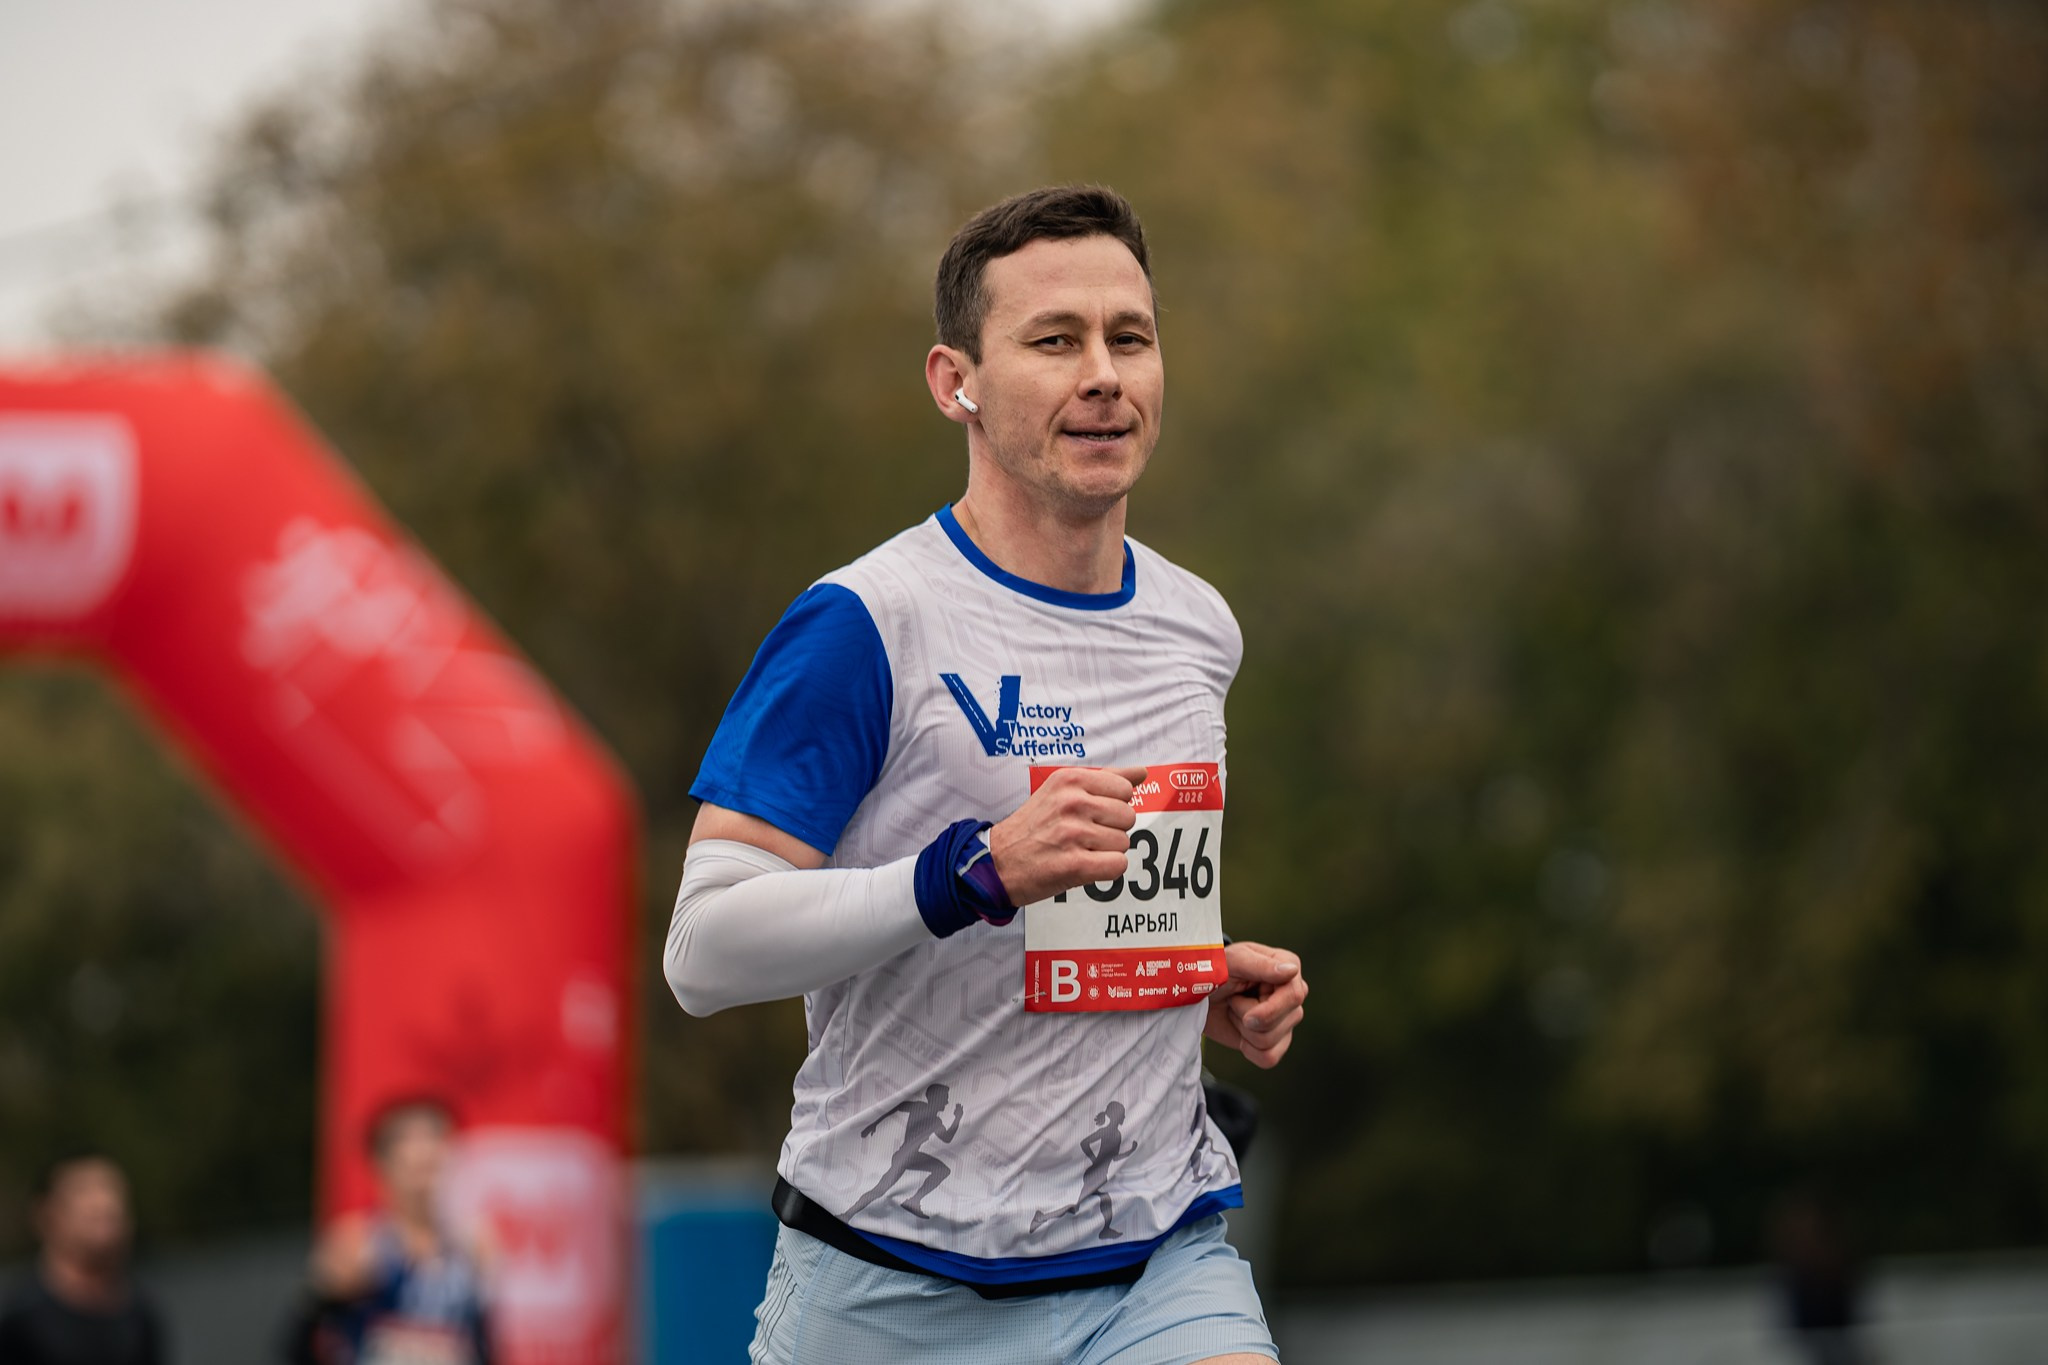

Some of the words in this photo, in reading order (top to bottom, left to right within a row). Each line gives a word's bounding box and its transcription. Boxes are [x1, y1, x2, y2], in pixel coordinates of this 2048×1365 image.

[938, 673, 1072, 757] Victory
[1003, 719, 1085, 741] Through
[994, 737, 1086, 758] Suffering
[1132, 781, 1160, 796] КИЙ
[1176, 773, 1188, 786] 10
[1178, 791, 1203, 804] 2026
[1054, 827, 1214, 903] 346
[1104, 912, 1178, 938] ДАРЬЯЛ
